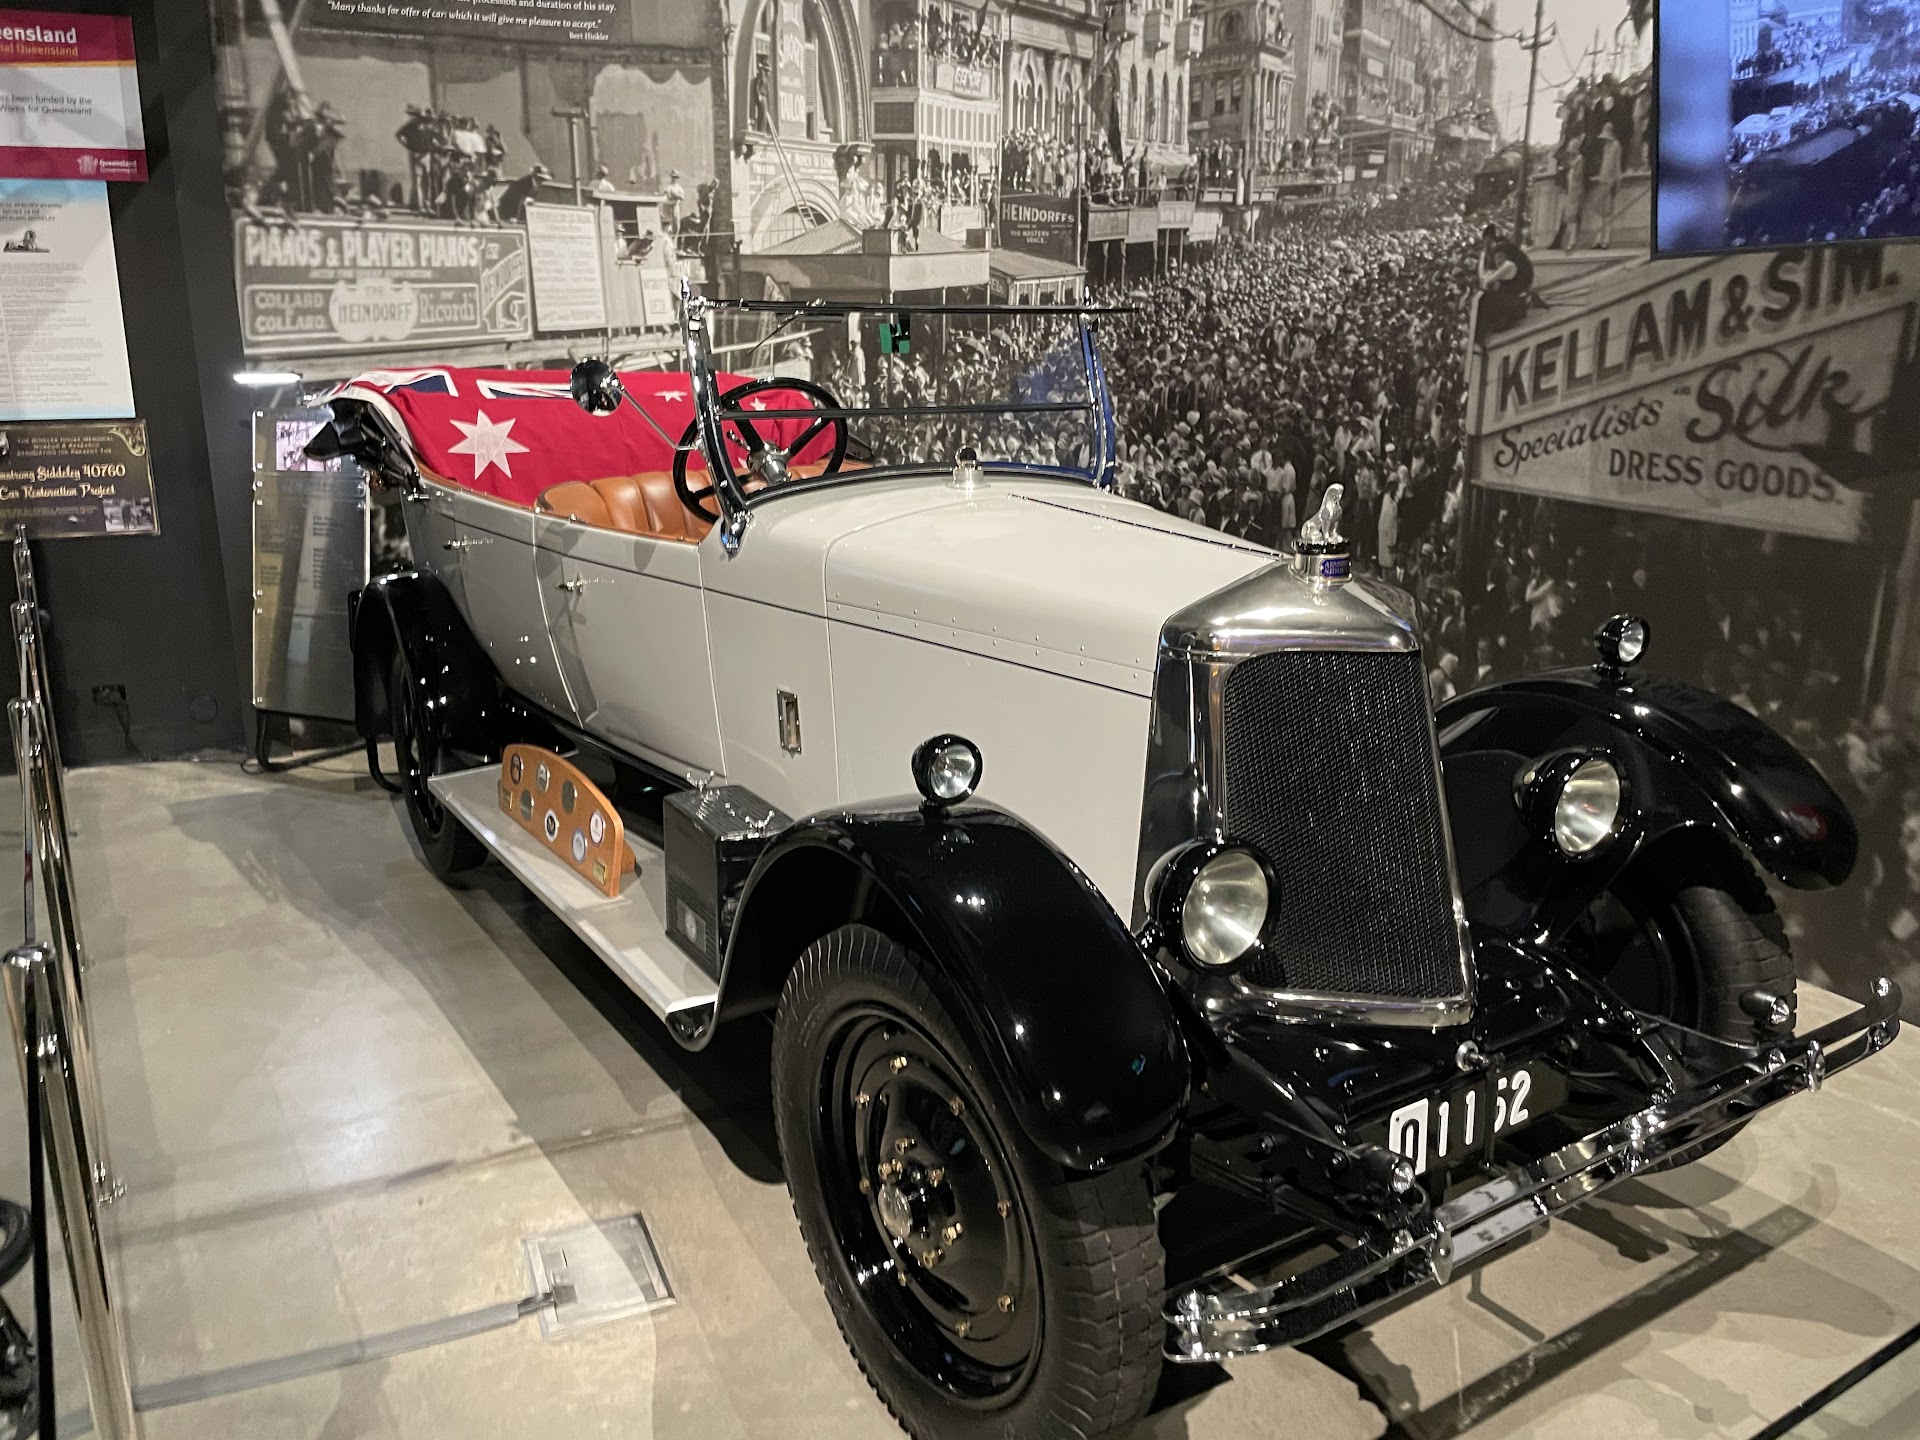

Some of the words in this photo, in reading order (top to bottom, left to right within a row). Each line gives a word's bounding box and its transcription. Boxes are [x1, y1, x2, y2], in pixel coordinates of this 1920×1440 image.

[357, 2, 386, 14] thanks
[387, 4, 399, 16] for
[400, 6, 420, 17] offer
[421, 7, 431, 18] of
[448, 9, 473, 20] which
[473, 11, 480, 21] it
[481, 12, 497, 22] will
[497, 14, 515, 25] give
[528, 16, 561, 28] pleasure
[536, 0, 571, 10] duration
[573, 1, 582, 10] of
[584, 1, 596, 11] his
[597, 3, 616, 14] stay.
[0, 25, 77, 44] ensland
[569, 31, 583, 40] Bert
[584, 32, 609, 40] Hinkler
[16, 43, 78, 57] Queensland
[36, 95, 65, 104] funded
[66, 96, 77, 106] by
[42, 106, 92, 116] Queensland
[1002, 202, 1075, 223] HEINDORFFS
[244, 226, 323, 267] PIANOS
[326, 237, 340, 267] &
[342, 230, 415, 267] PLAYER
[419, 233, 479, 268] PIANOS
[255, 291, 324, 309] COLLARD
[420, 292, 475, 323] Ricordi
[338, 302, 413, 324] HEINDORFF
[255, 315, 327, 333] COLLARD
[1499, 278, 1714, 415] KELLAM
[1720, 274, 1755, 338] &
[1685, 346, 1886, 453] Silk
[1494, 397, 1663, 473] Specialists
[37, 464, 81, 482] Siddeley
[82, 463, 126, 478] 40760
[1609, 448, 1703, 486] DRESS
[0, 485, 20, 500] Car
[21, 484, 78, 499] Restoration
[79, 482, 115, 498] Project
